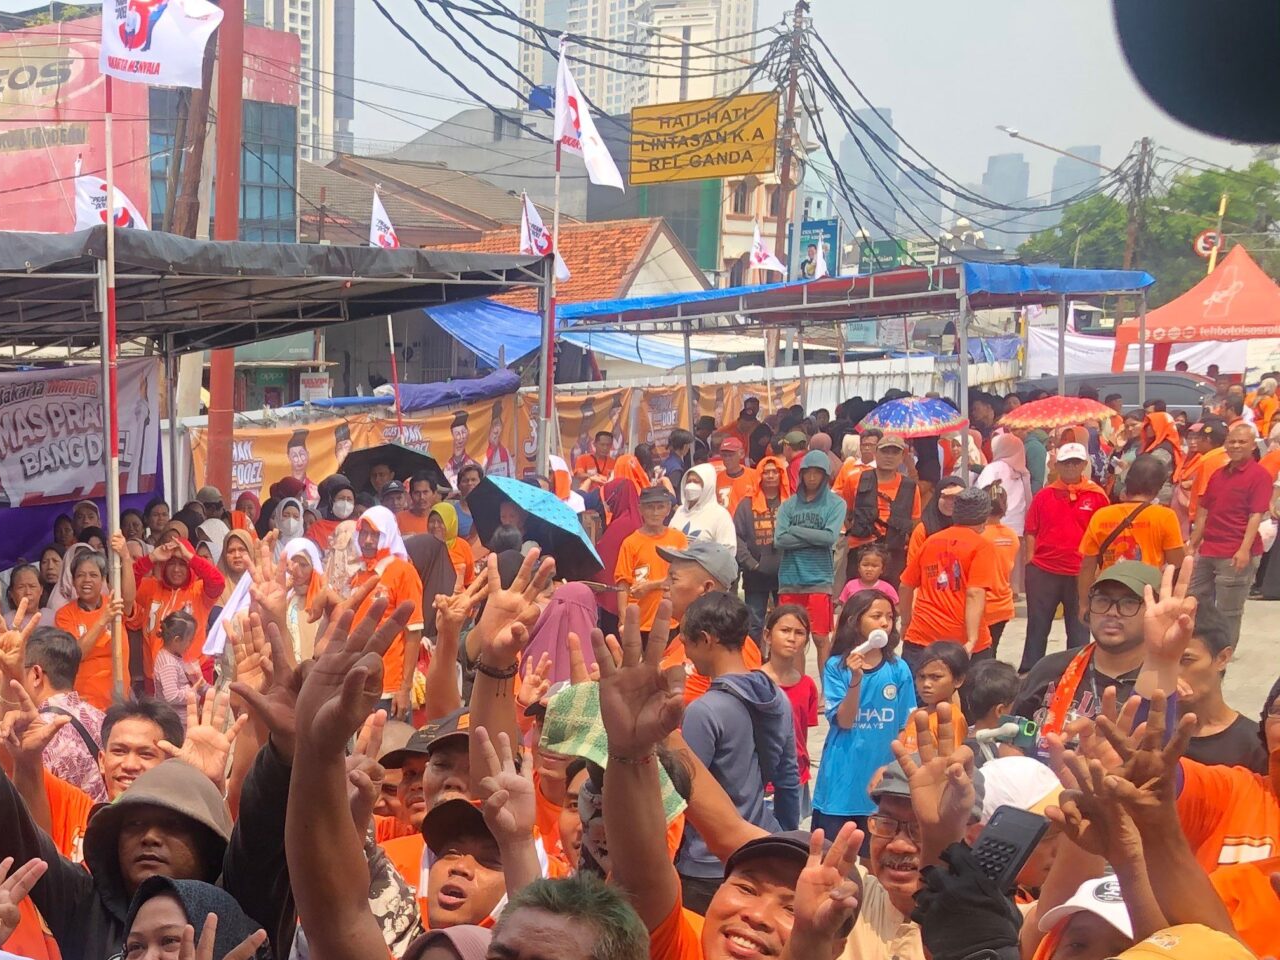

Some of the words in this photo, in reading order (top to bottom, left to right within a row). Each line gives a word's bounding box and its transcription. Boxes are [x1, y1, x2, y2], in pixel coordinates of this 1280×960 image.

[659, 107, 749, 129] HATI-HATI
[640, 131, 728, 152] LINTASAN
[732, 127, 765, 144] K.A
[688, 150, 754, 168] GANDA
[46, 402, 105, 437] PRA
[21, 437, 86, 480] BANG
[85, 430, 133, 467] DEL
[853, 722, 884, 730] RWAYS
[855, 708, 895, 722] HAD
